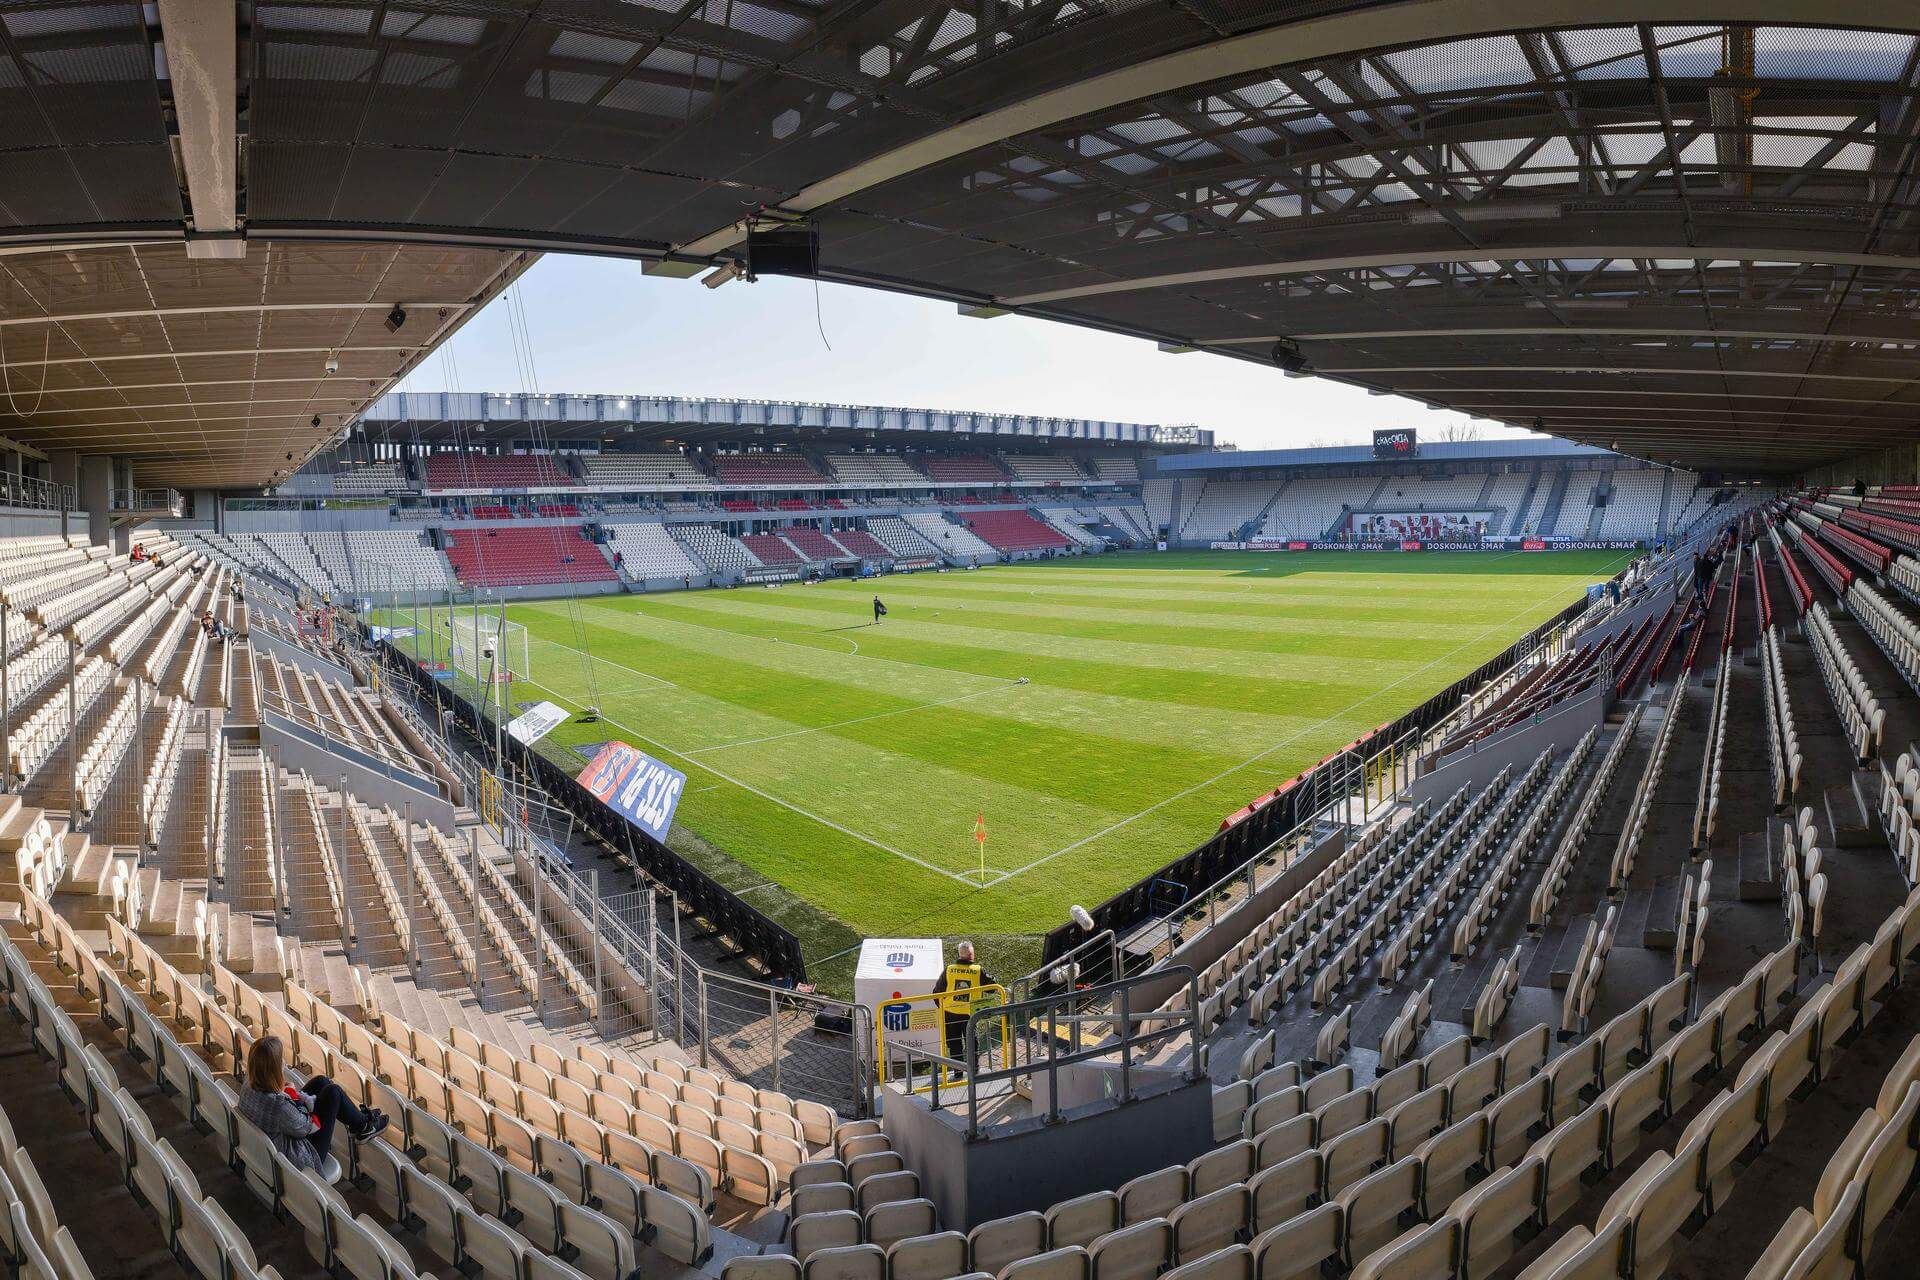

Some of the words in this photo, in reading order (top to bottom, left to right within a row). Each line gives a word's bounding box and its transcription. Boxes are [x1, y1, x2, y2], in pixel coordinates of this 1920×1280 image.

[1312, 542, 1359, 550] DOSKONAŁY
[1361, 542, 1384, 550] SMAK
[1427, 542, 1479, 550] DOSKONAŁY
[1481, 542, 1505, 550] SMAK
[1552, 542, 1607, 550] DOSKONAŁY
[1610, 541, 1636, 549] SMAK
[617, 759, 680, 831] STS.PL
